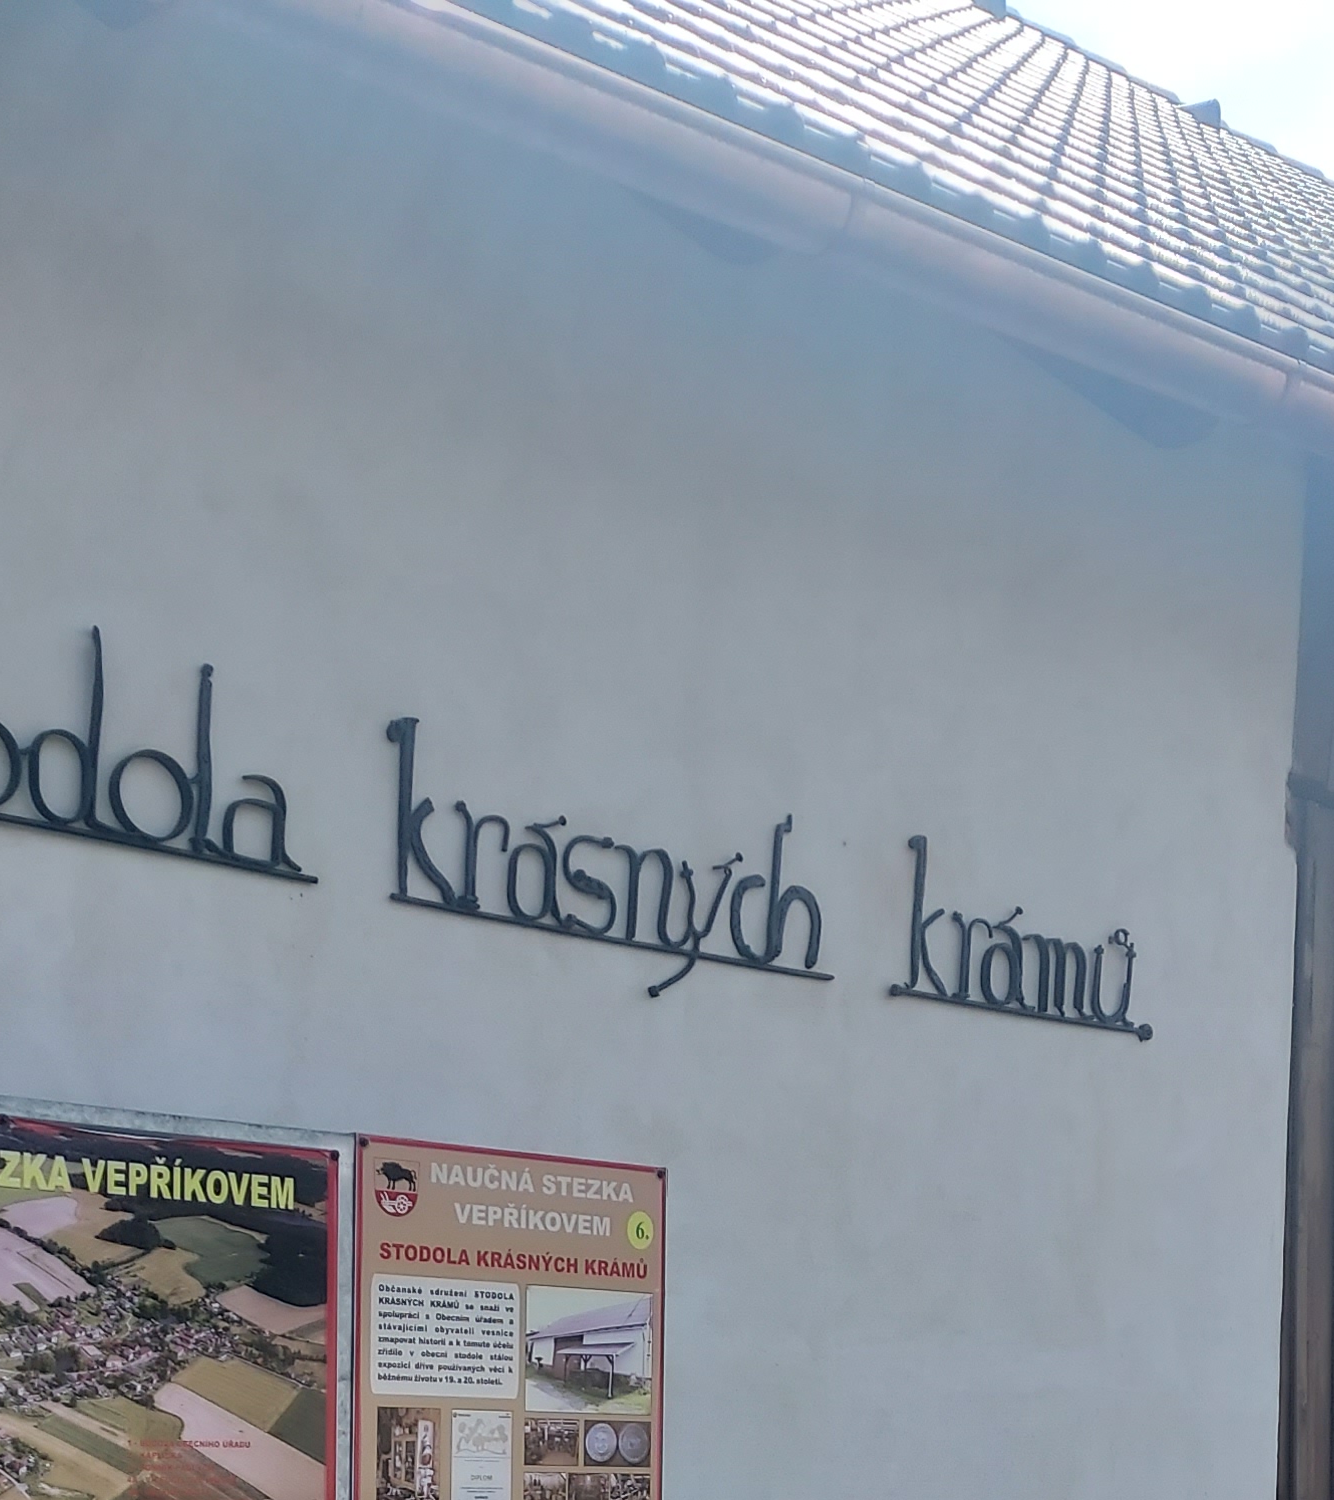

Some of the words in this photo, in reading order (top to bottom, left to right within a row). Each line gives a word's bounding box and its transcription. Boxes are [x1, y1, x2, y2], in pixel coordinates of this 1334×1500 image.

[389, 716, 834, 996] krásných
[891, 835, 1153, 1039] krámů
[81, 1155, 296, 1212] VEPŘÍKOVEM
[430, 1162, 534, 1193] NAUČNÁ
[542, 1174, 634, 1202] STEZKA
[454, 1201, 612, 1237] VEPŘÍKOVEM
[635, 1221, 650, 1240] 6.
[379, 1242, 470, 1267] STODOLA
[477, 1247, 578, 1274] KRÁSNÝCH
[585, 1257, 648, 1279] KRÁMŮ
[474, 1291, 514, 1300] STODOLA
[378, 1336, 415, 1345] zmapovat
[435, 1325, 474, 1335] obyvateli
[481, 1329, 513, 1337] vesnice
[454, 1351, 483, 1360] stodole
[463, 1376, 475, 1384] 20.
